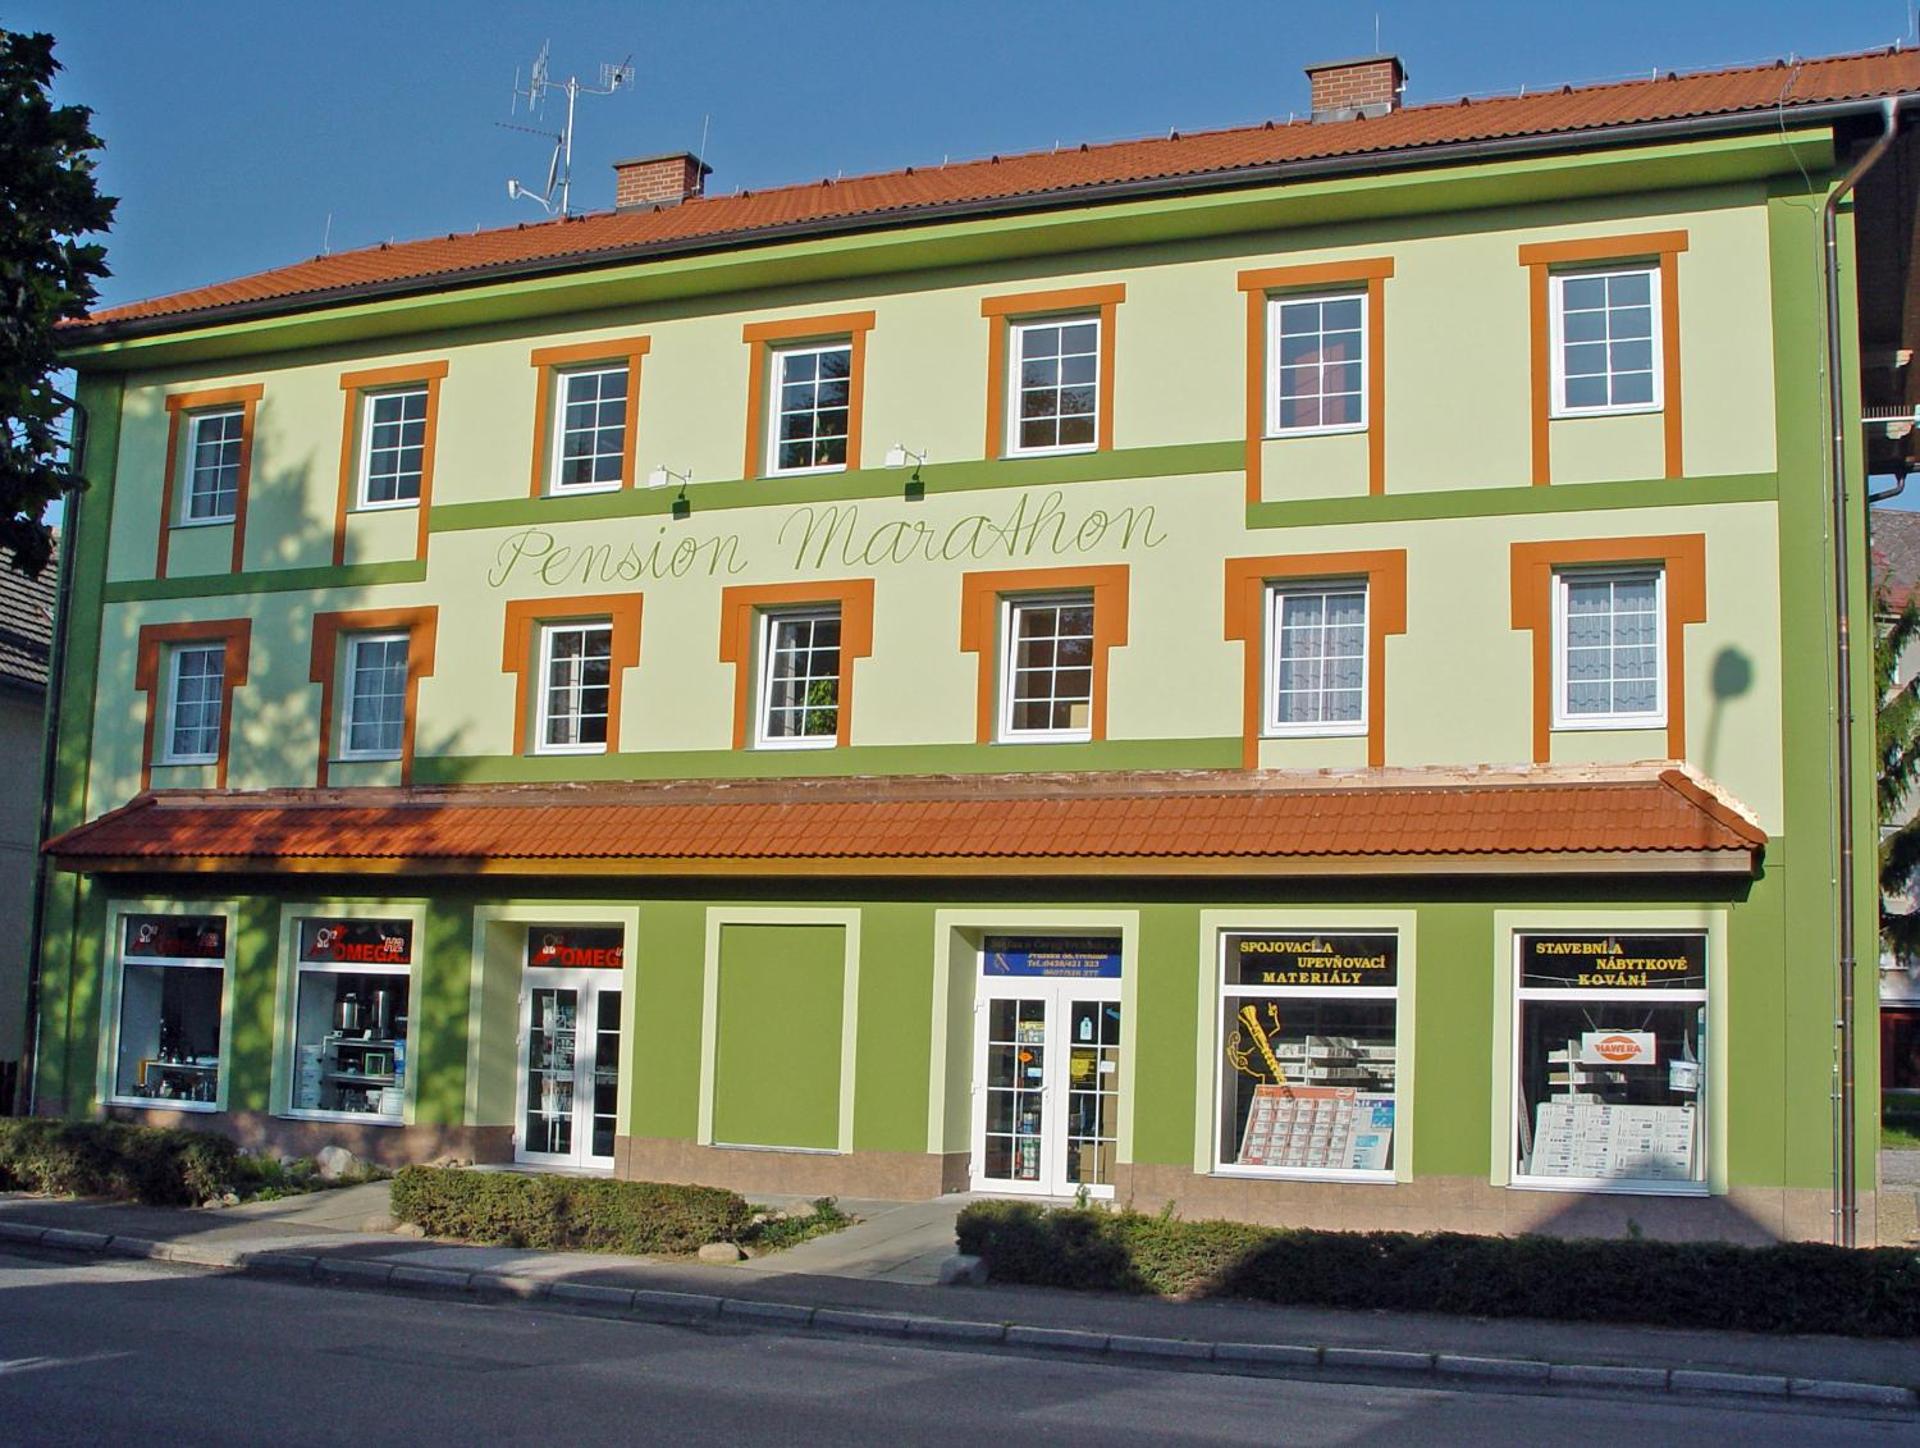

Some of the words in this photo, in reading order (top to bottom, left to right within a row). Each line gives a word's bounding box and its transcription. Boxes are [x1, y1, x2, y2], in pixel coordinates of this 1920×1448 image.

[487, 525, 748, 589] Pension
[778, 490, 1167, 571] Marathon
[1240, 939, 1316, 953] SPOJOVACÍ
[1323, 943, 1334, 953] A
[1536, 940, 1608, 954] STAVEBNÍ
[1612, 943, 1624, 954] A
[1297, 953, 1386, 969] UPEVŇOVACÍ
[1596, 956, 1688, 971] NÁBYTKOVÉ
[1263, 969, 1362, 984] MATERIÁLY
[1578, 972, 1649, 986] KOVÁNÍ
